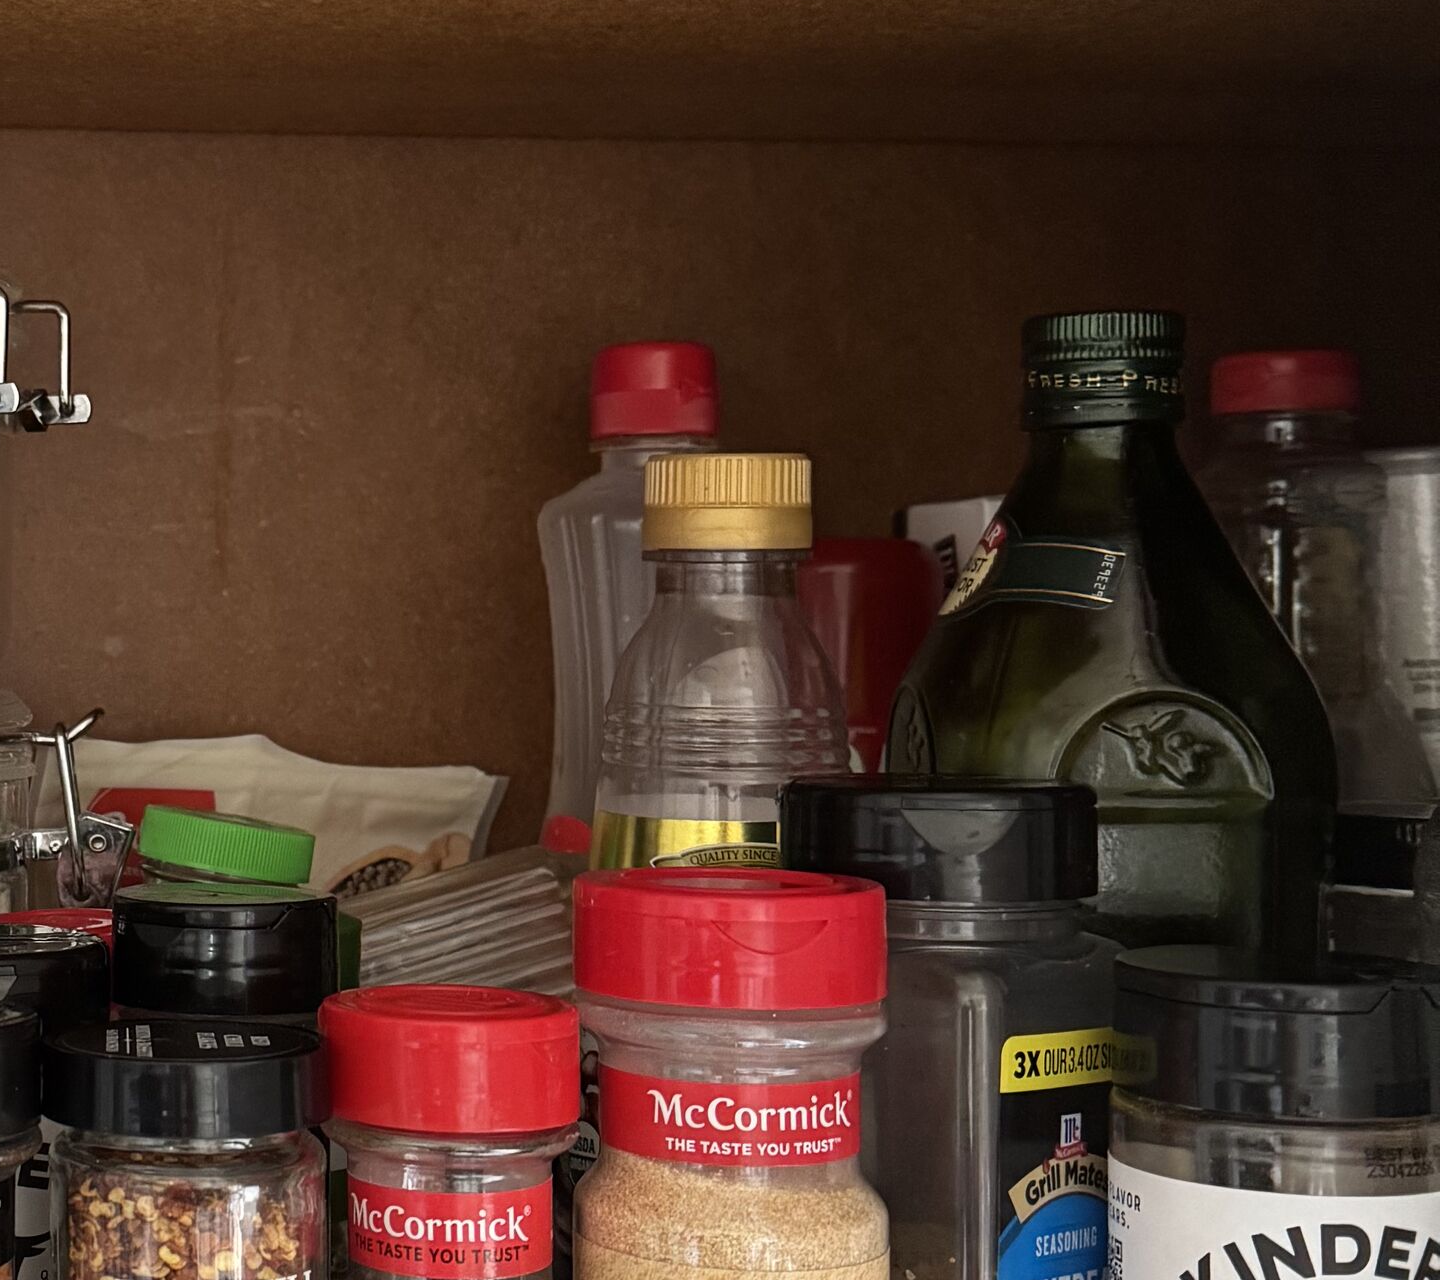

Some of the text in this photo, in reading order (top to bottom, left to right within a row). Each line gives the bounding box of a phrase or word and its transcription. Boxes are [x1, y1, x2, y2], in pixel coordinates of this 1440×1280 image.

[690, 849, 776, 865] QUALITY SINCE
[1013, 1051, 1040, 1079] 3X
[646, 1088, 848, 1132] McCormick
[664, 1136, 835, 1157] THE TASTE YOU TRUST
[351, 1192, 528, 1243] McCormick
[376, 1239, 522, 1264] TASTE YOU TRUST
[1035, 1226, 1097, 1258] SEASONING
